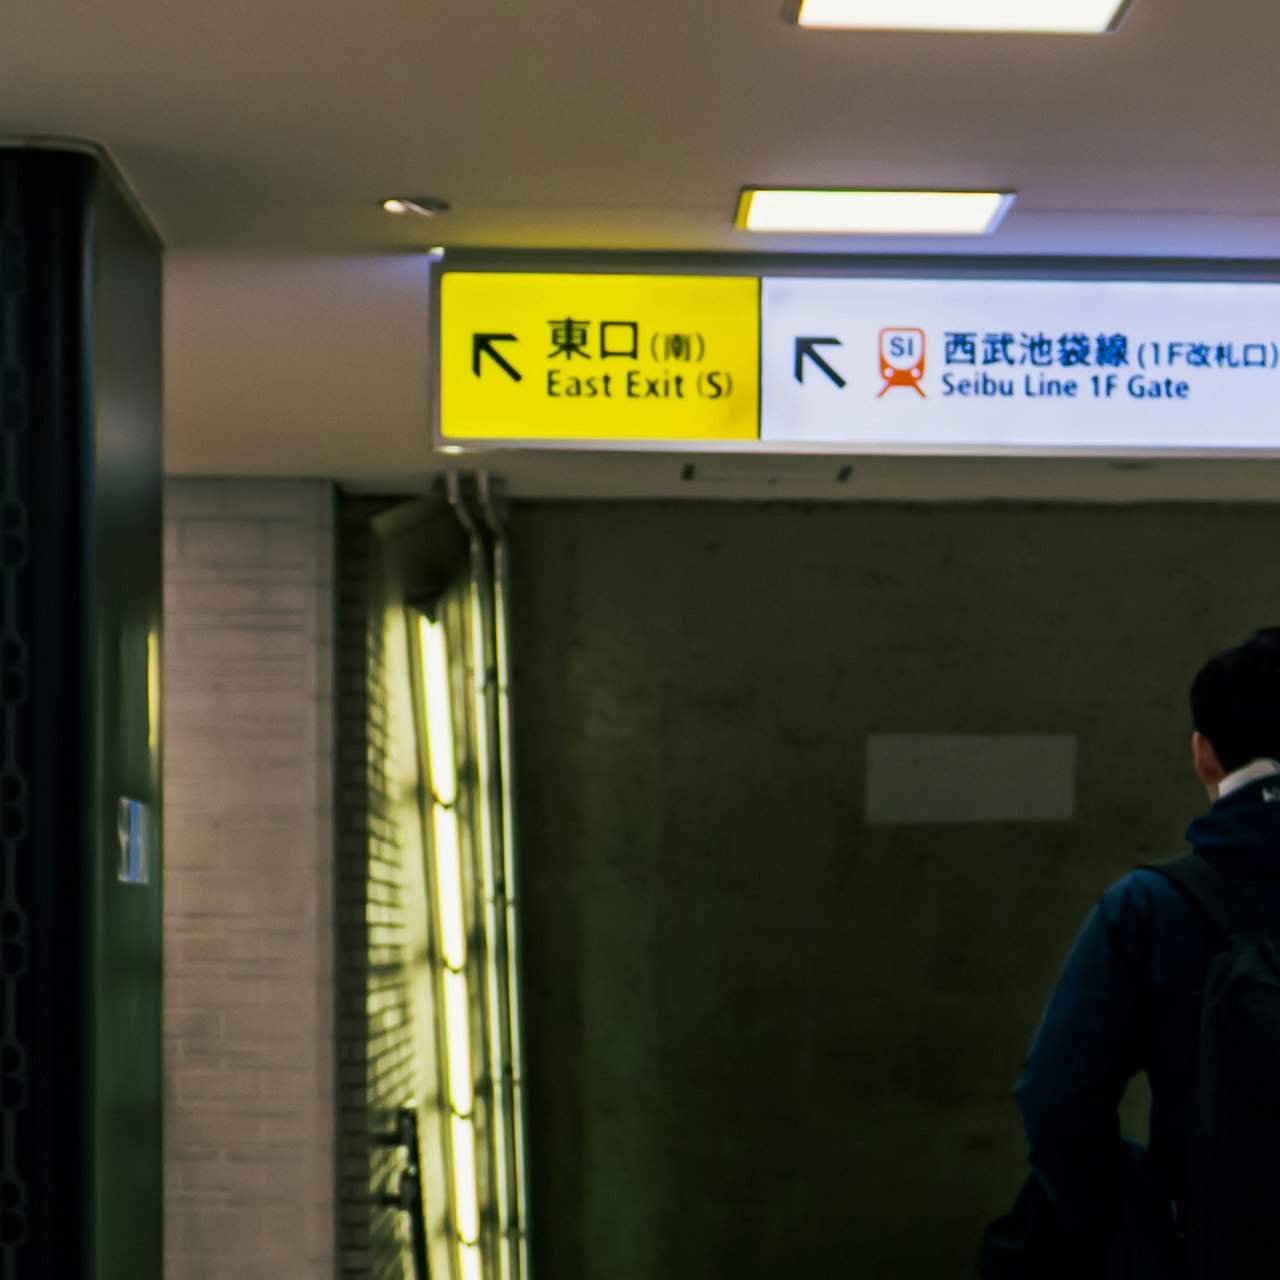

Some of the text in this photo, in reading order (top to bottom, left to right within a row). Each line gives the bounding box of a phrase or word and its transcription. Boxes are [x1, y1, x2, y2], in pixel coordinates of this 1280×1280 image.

[547, 369, 733, 400] East Exit (S)
[942, 372, 1190, 400] Seibu Line 1F Gate
